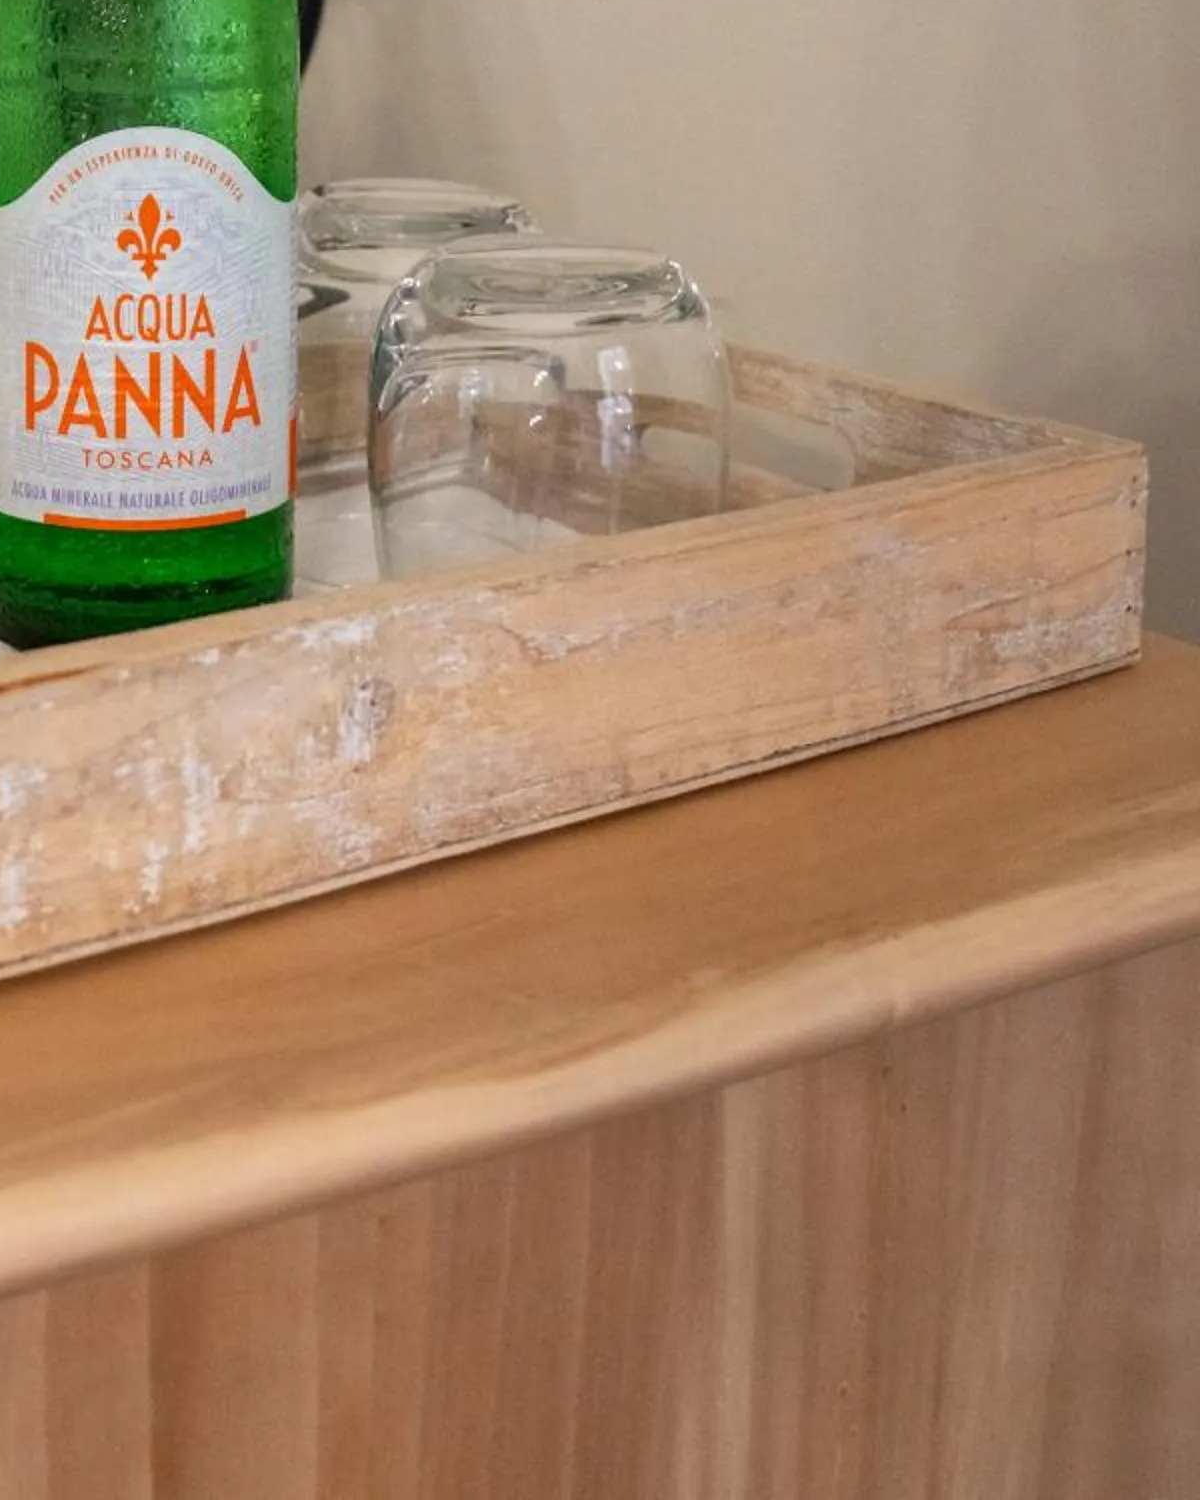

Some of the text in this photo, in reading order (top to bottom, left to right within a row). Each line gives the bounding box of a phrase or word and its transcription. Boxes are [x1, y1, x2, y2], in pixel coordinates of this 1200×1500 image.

[84, 293, 215, 344] ACQUA
[24, 340, 262, 439] PANNA
[81, 448, 213, 471] TOSCANA
[10, 479, 47, 500] ACQUA
[51, 486, 113, 509] MINERALE
[119, 490, 185, 510] NATURALE
